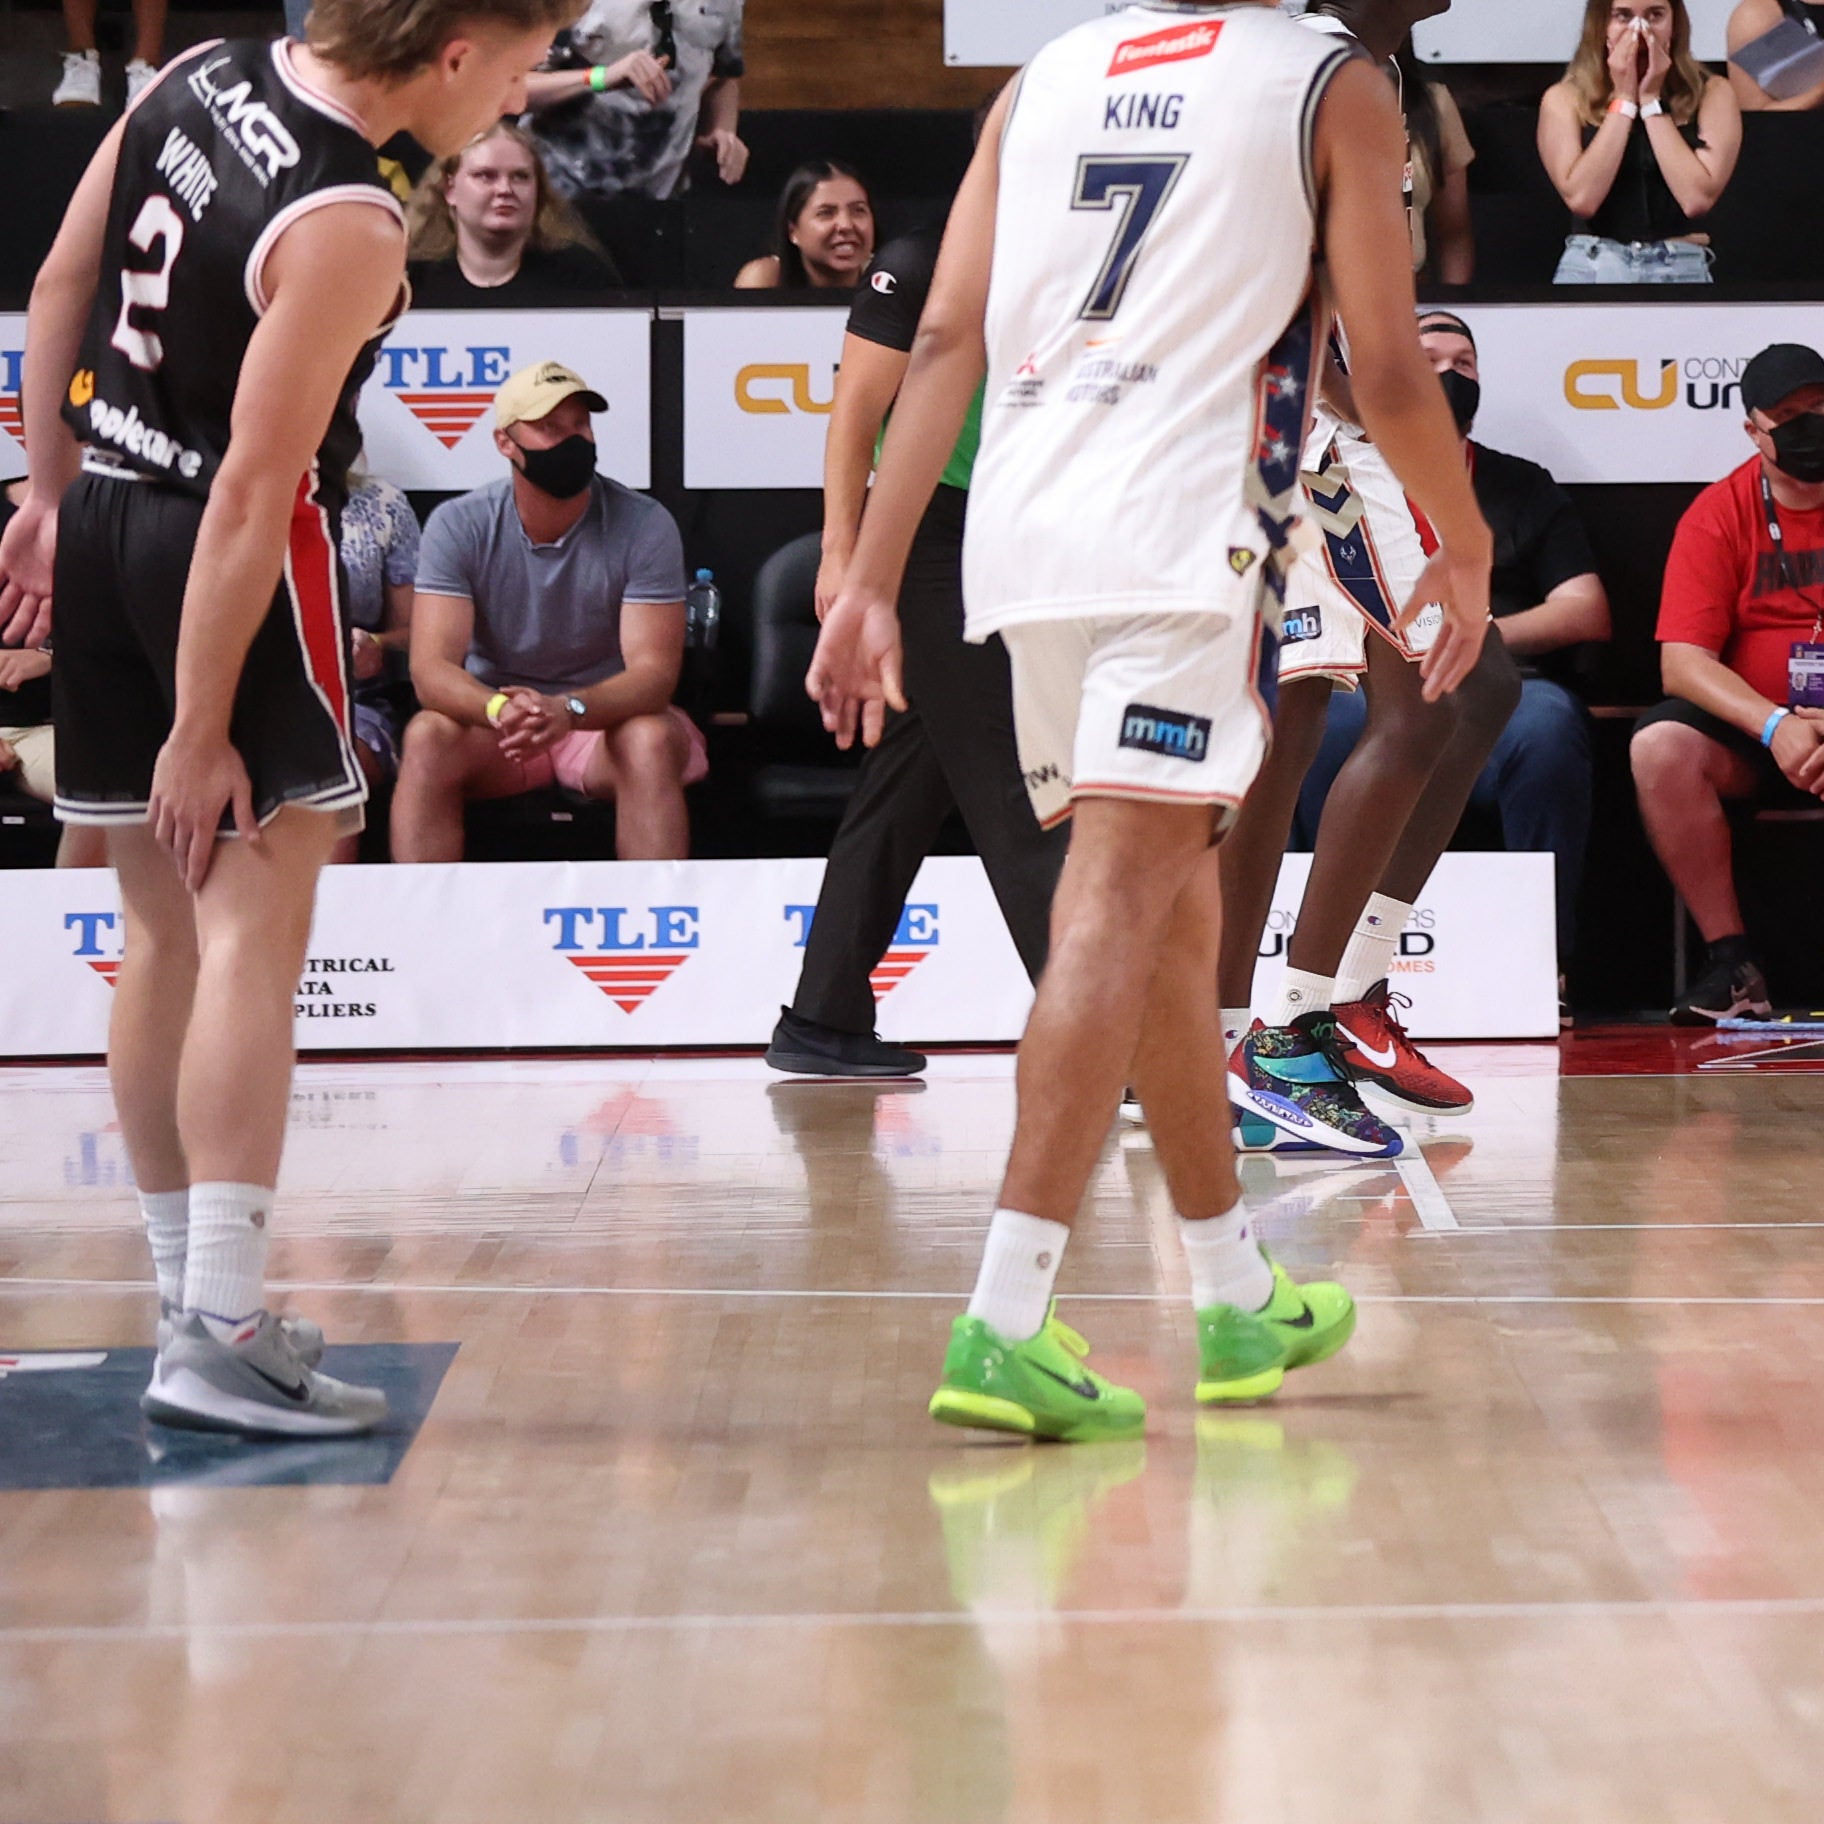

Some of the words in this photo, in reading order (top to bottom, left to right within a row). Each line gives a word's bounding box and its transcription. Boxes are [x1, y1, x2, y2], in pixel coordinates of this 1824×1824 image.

[1103, 93, 1185, 131] KING
[156, 125, 220, 223] WHITE
[1069, 152, 1190, 322] 7
[109, 193, 185, 373] 2
[381, 346, 511, 388] TLE
[1281, 611, 1319, 637] mh
[1123, 711, 1206, 753] mmh
[542, 906, 700, 951] TLE
[306, 957, 395, 973] TRICAL
[297, 1001, 377, 1018] PLIERS
